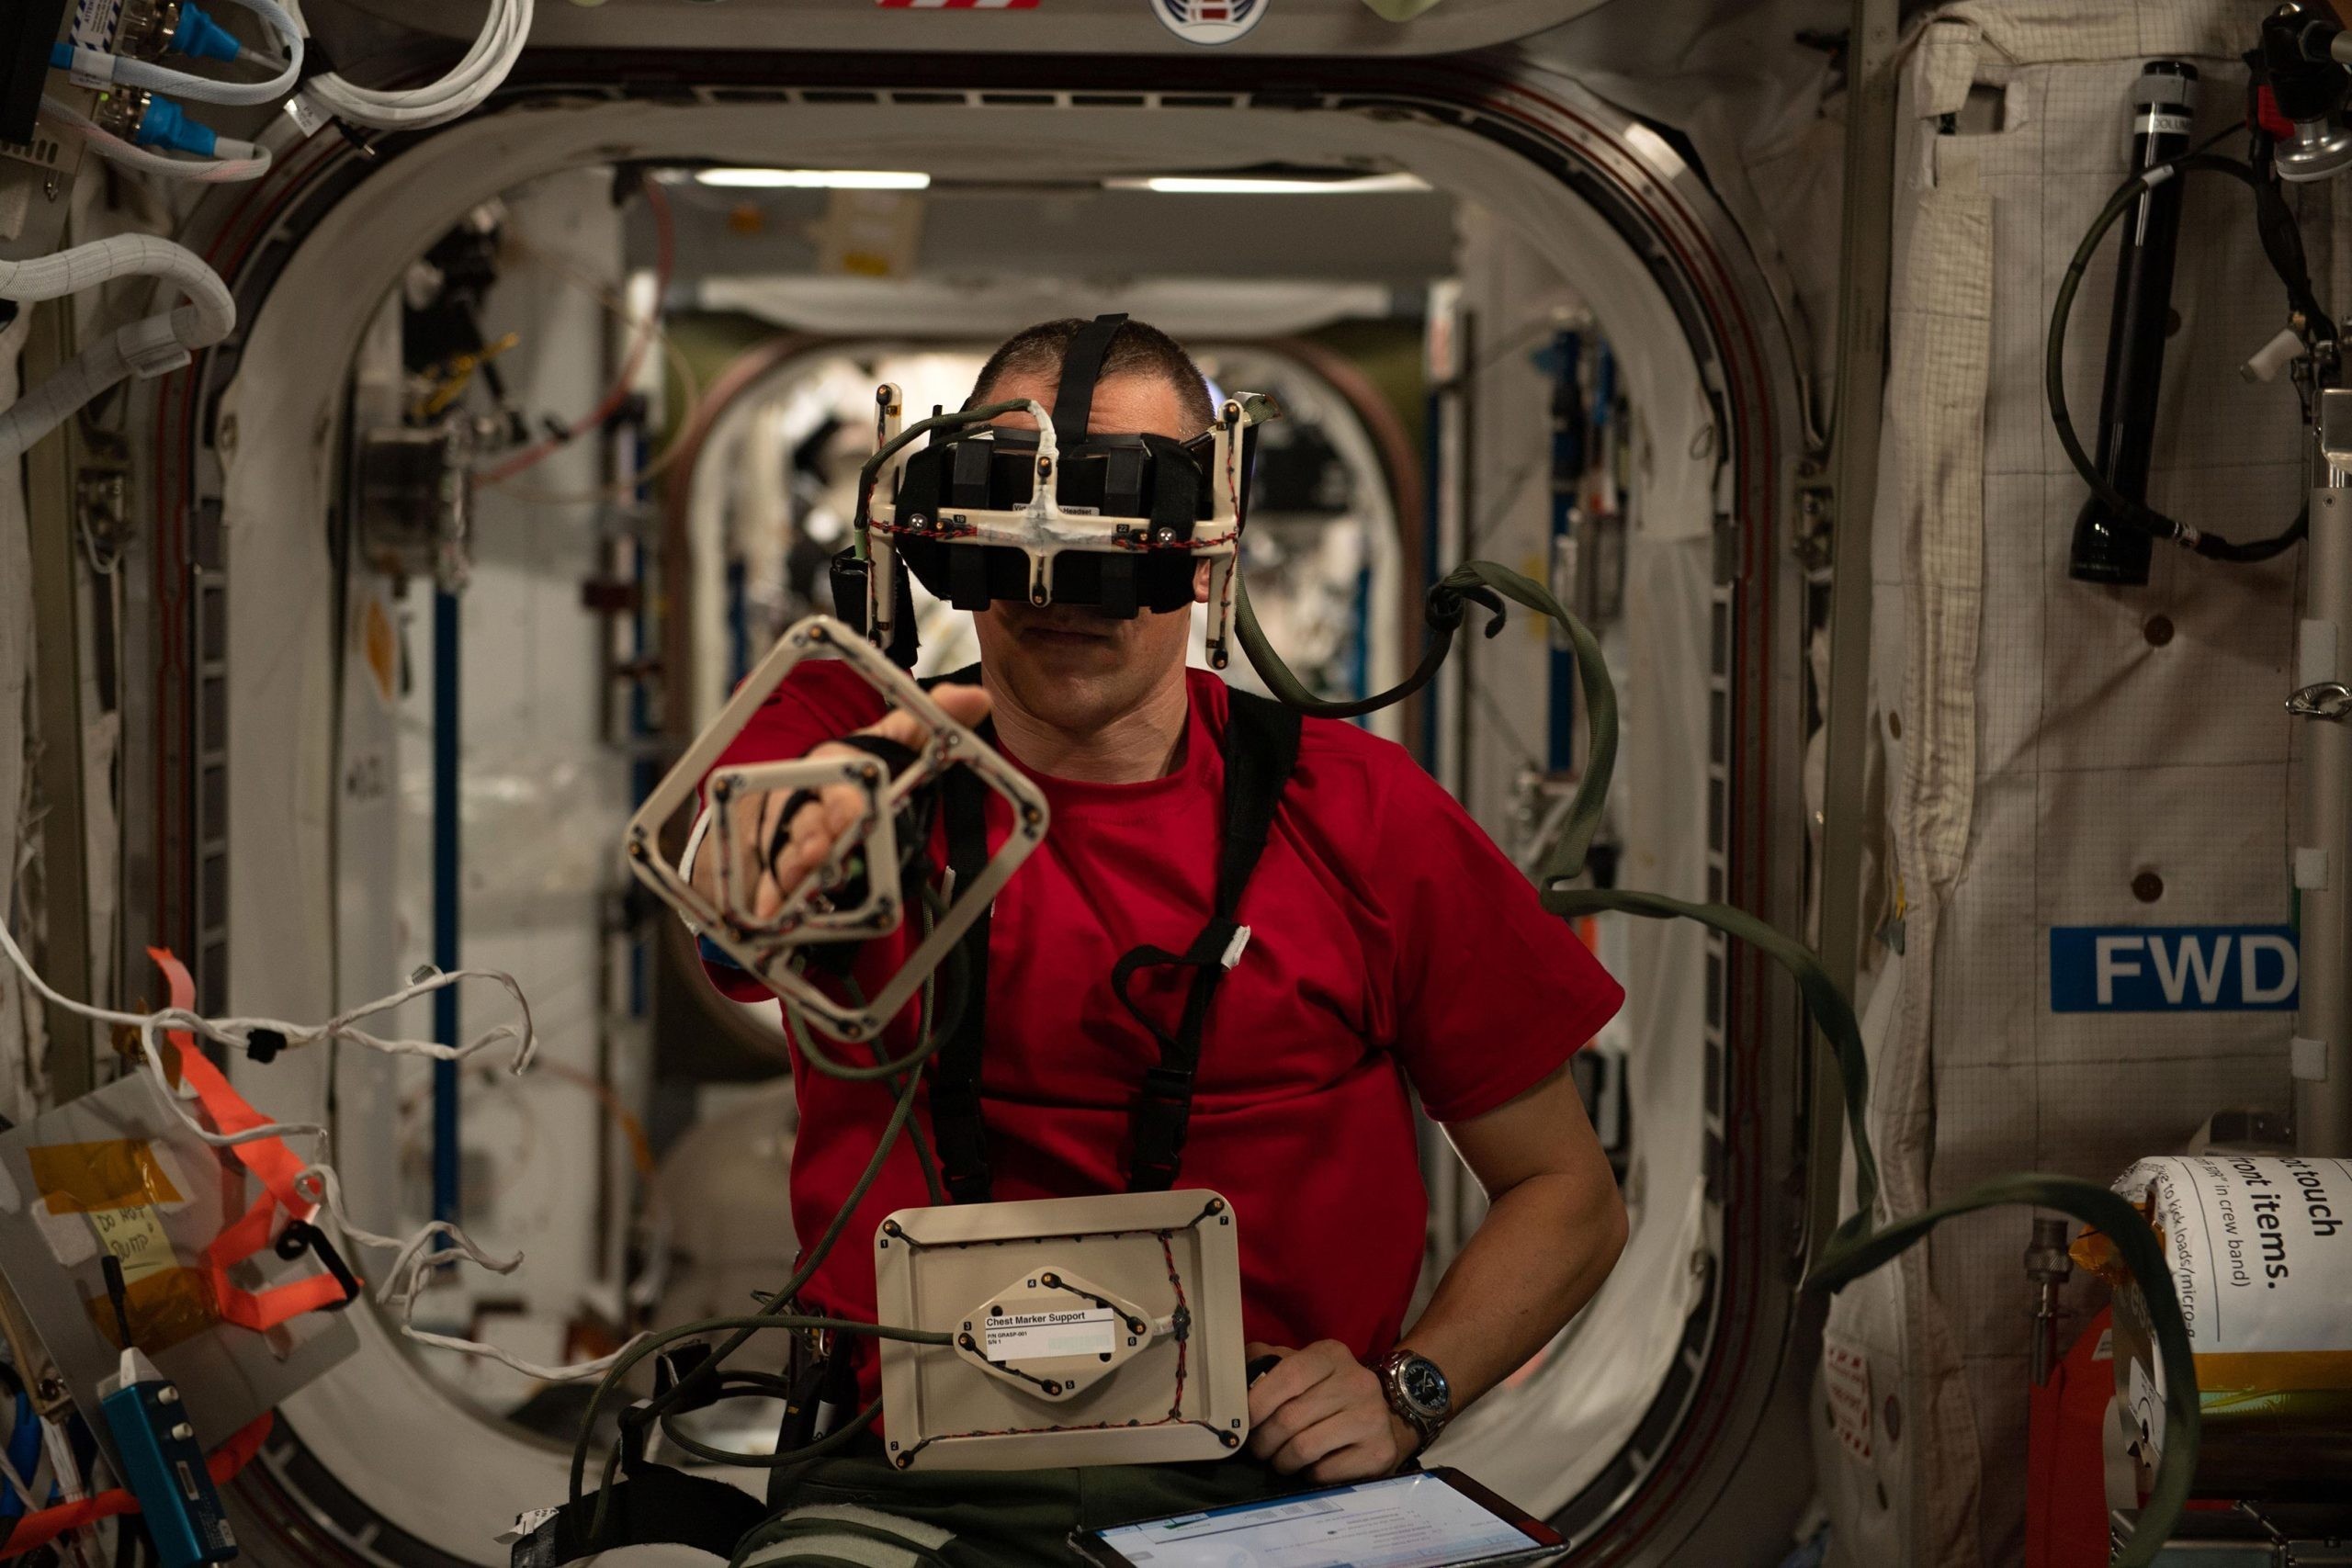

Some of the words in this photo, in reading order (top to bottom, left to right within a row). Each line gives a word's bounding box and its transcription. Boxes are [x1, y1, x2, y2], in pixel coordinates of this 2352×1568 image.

[2095, 934, 2299, 1004] FWD
[2215, 1184, 2228, 1196] in
[2292, 1170, 2343, 1236] touch
[96, 1214, 116, 1233] DO
[2219, 1201, 2238, 1235] crew
[2251, 1194, 2289, 1289] items.
[2227, 1240, 2251, 1287] band)
[986, 1316, 1013, 1326] Chest
[1015, 1314, 1046, 1325] Marker
[1048, 1311, 1086, 1324] Support
